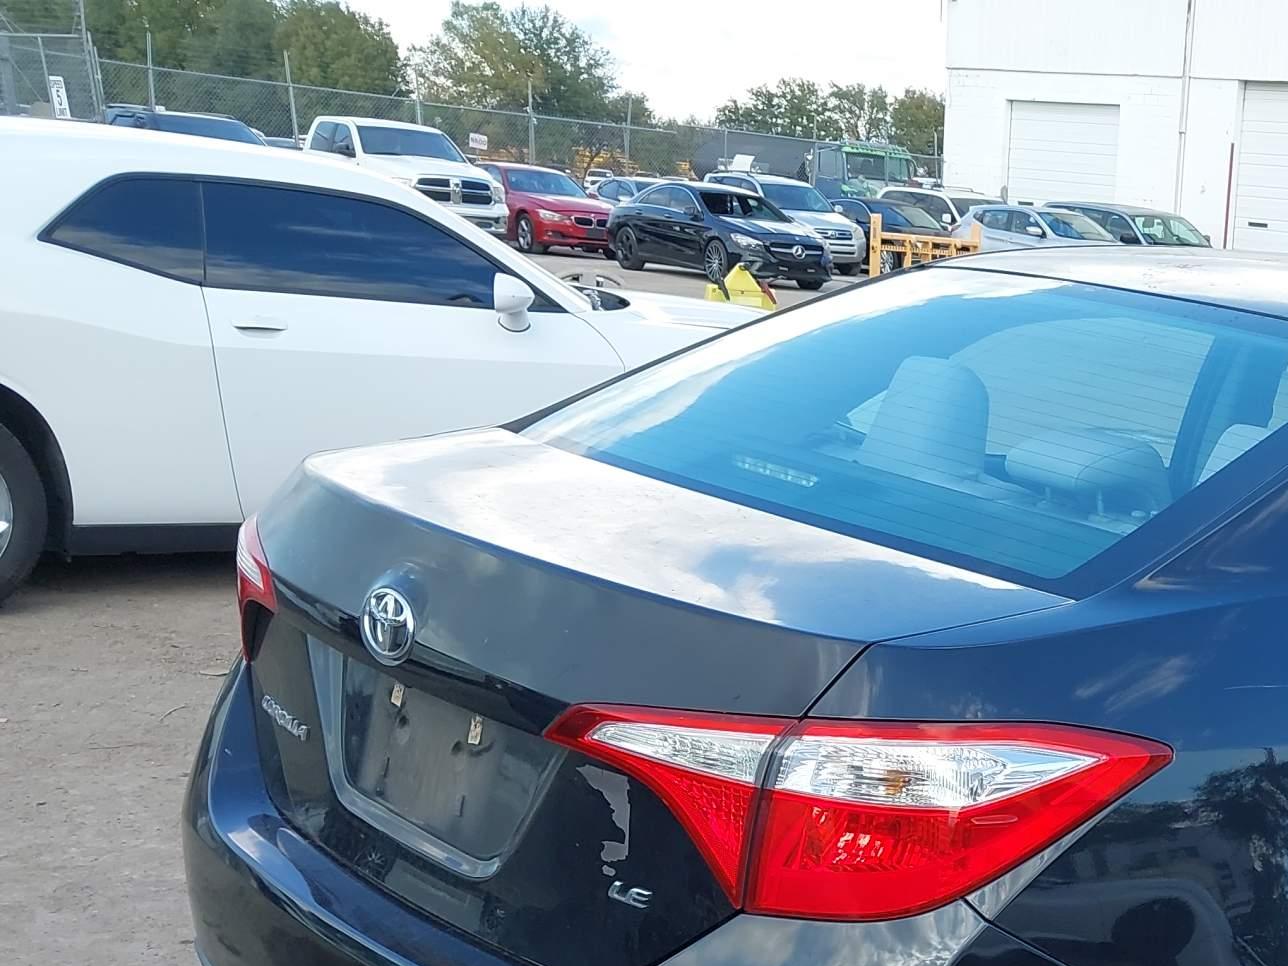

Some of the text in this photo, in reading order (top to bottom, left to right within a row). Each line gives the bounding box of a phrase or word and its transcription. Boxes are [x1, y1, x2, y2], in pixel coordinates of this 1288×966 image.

[56, 89, 63, 107] 5
[261, 695, 310, 741] COROLLA
[608, 880, 653, 909] LE
